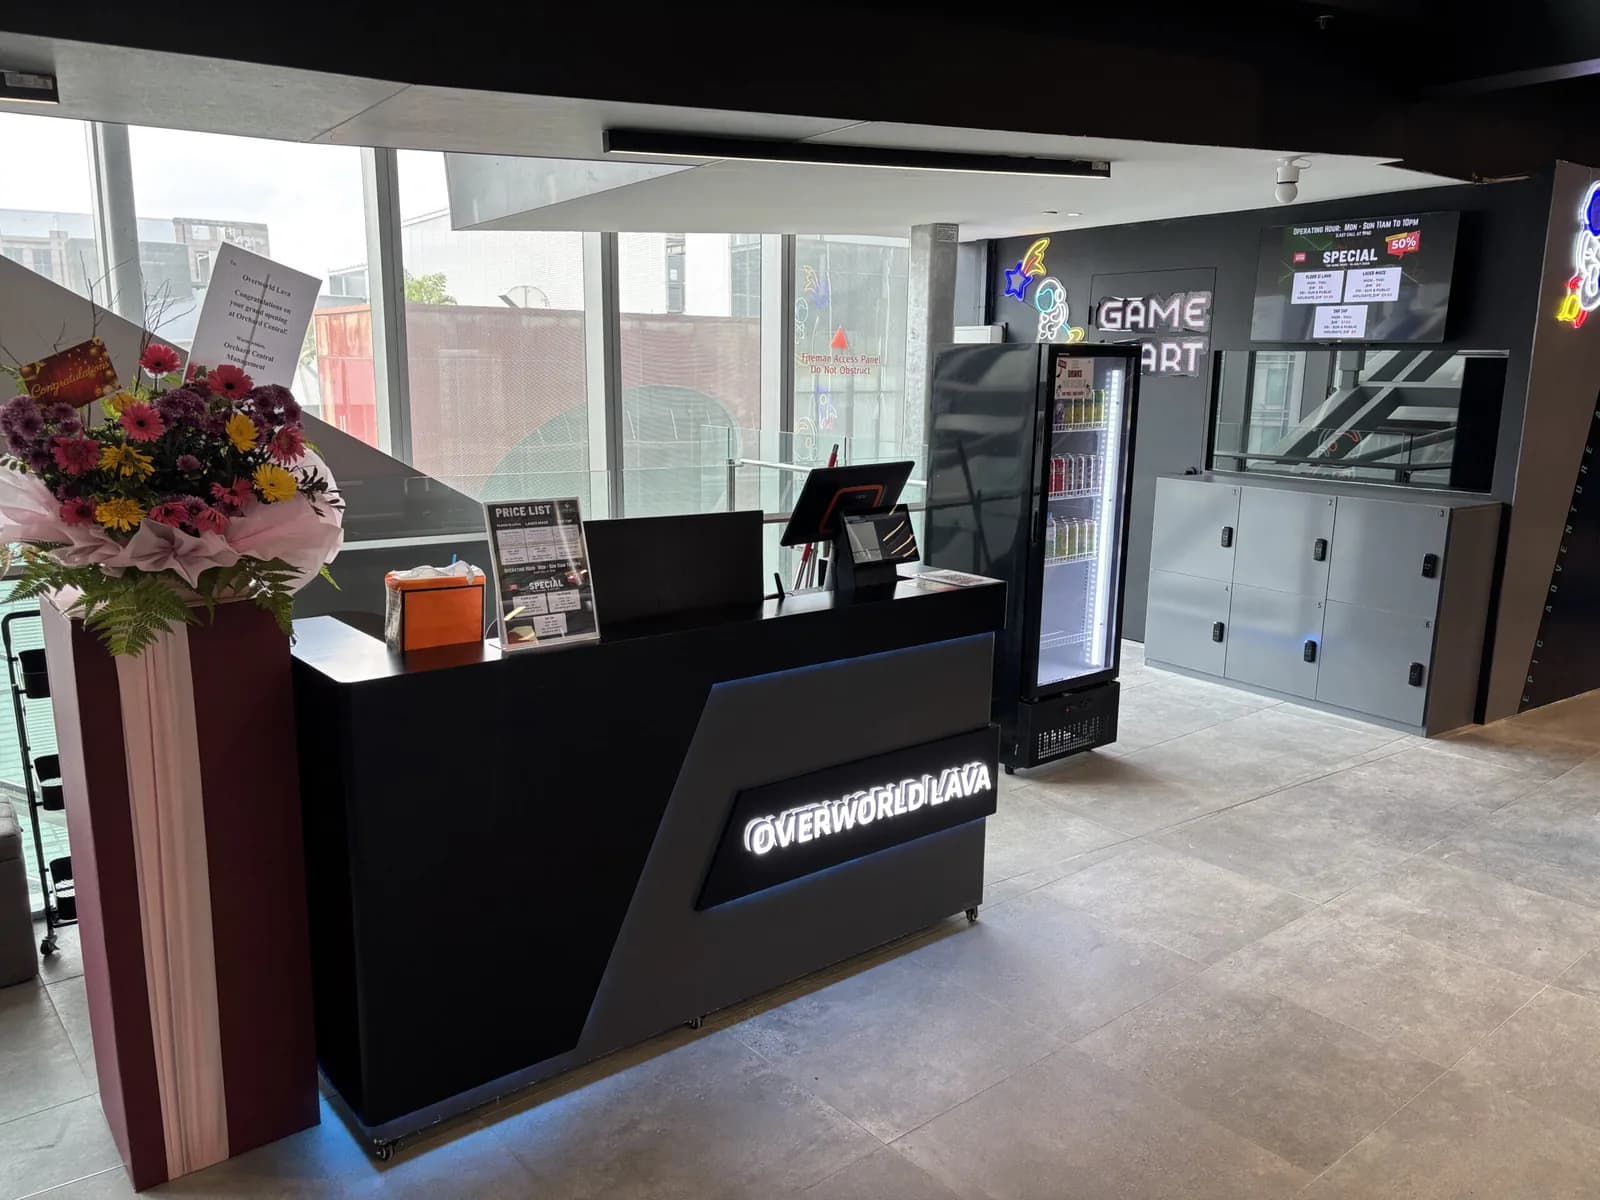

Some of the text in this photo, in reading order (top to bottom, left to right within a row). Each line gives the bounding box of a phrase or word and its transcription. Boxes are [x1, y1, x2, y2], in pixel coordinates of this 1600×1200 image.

[1293, 226, 1323, 236] OPERATING
[1344, 223, 1357, 231] MON
[1363, 222, 1375, 230] SUN
[1377, 220, 1391, 228] 11AM
[1393, 219, 1400, 227] TO
[1402, 218, 1419, 226] 10PM
[1392, 237, 1416, 250] 50%
[1322, 248, 1378, 264] SPECIAL
[276, 285, 292, 297] Lava
[264, 310, 288, 325] opening
[1100, 298, 1206, 329] GAME
[251, 350, 274, 362] Central
[802, 352, 880, 364] Fireman Access Panel
[1141, 343, 1203, 372] ART
[810, 365, 870, 375] Do Not Obstruct
[31, 361, 110, 399] Congratulations
[496, 506, 526, 518] PRICE
[528, 505, 551, 516] LIST
[1546, 446, 1592, 613] ADVENTURE
[529, 579, 564, 591] SPECIAL
[1523, 640, 1544, 702] EPIC
